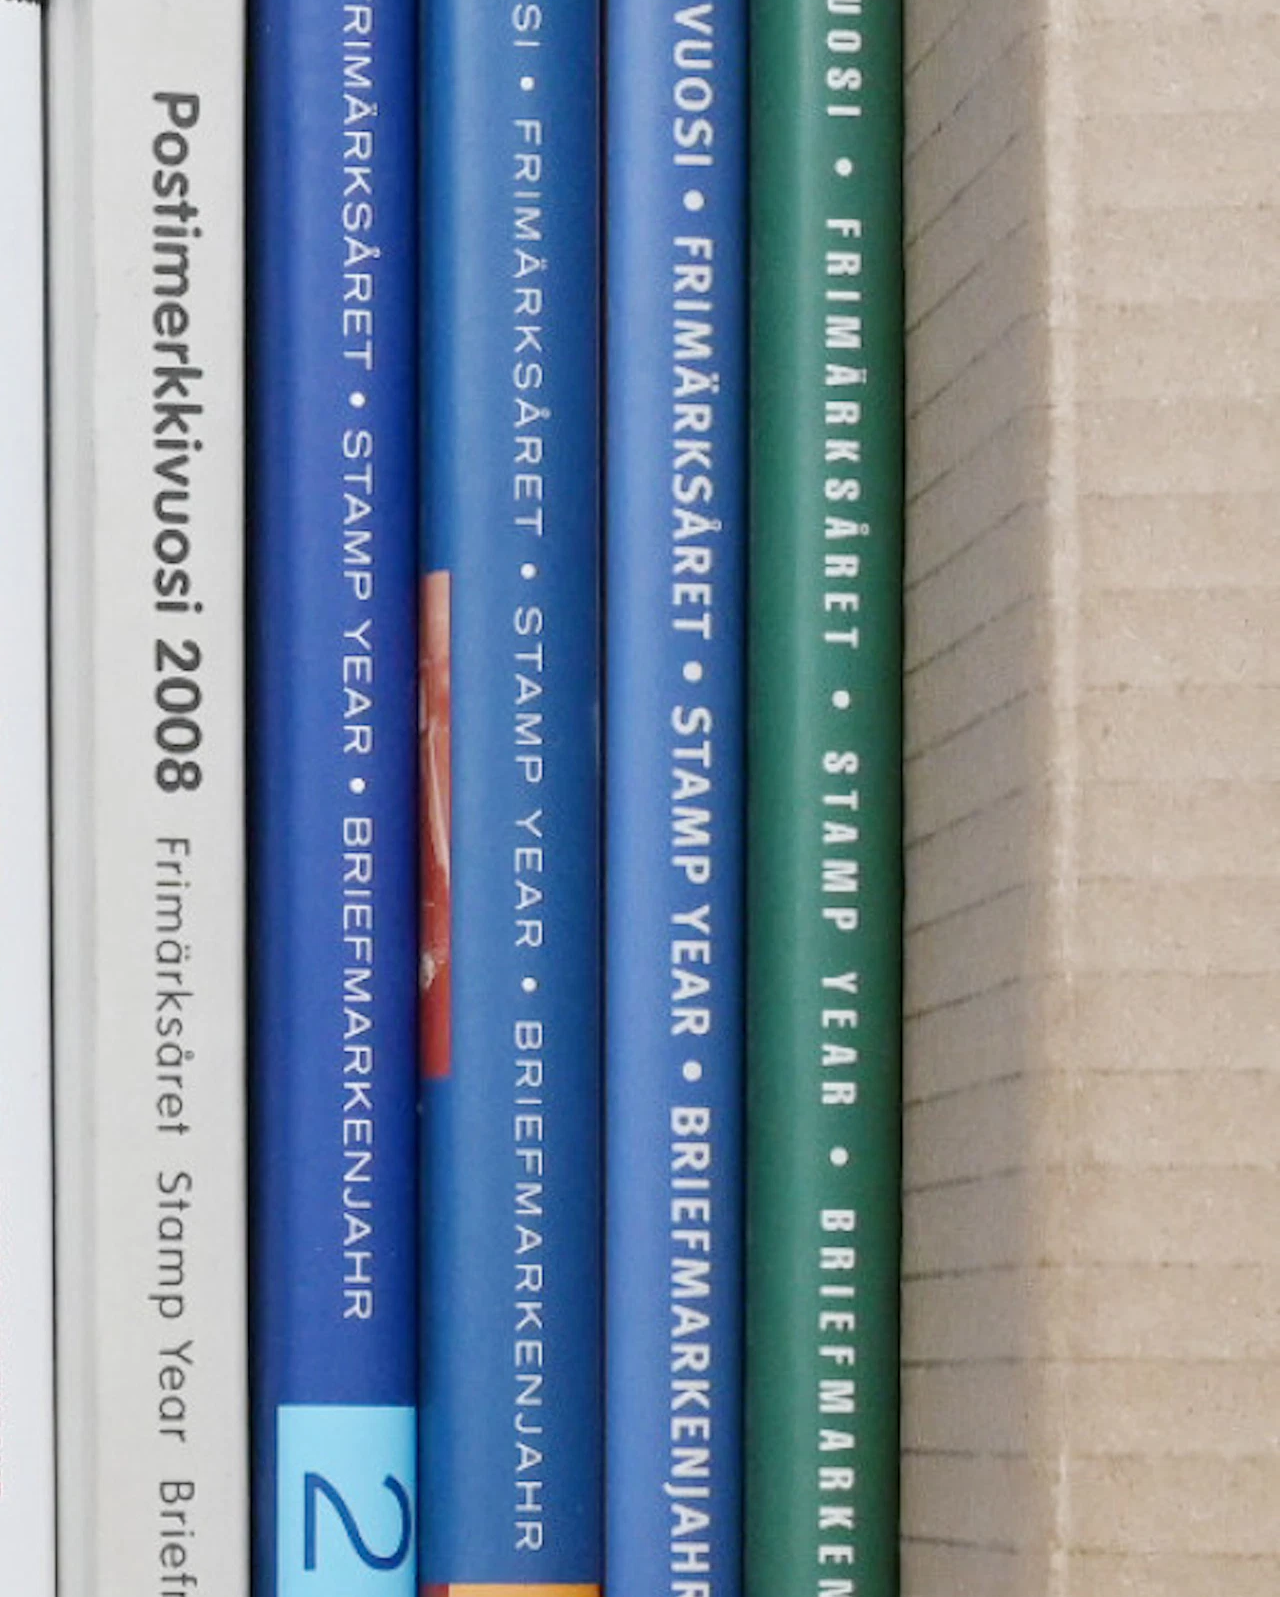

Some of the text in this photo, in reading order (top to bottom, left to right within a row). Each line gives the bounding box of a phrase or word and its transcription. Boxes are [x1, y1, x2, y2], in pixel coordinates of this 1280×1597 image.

[152, 91, 201, 613] Postimerkkivuosi
[512, 119, 552, 536] FRIMÄRKSÅRET
[342, 429, 372, 602] STAMP
[671, 235, 721, 639] FRIMÄRKSÅRET
[822, 218, 869, 650] FRIMÄRKSÅRET
[154, 638, 201, 793] 2008
[342, 621, 372, 755] YEAR
[513, 606, 543, 785] STAMP
[514, 811, 543, 948] YEAR
[670, 706, 711, 884] STAMP
[822, 751, 857, 934] STAMP
[155, 836, 193, 1137] Frimärksåret
[670, 904, 711, 1036] YEAR
[821, 973, 856, 1109] YEAR
[342, 818, 372, 1319] BRIEFMARKENJAHR
[150, 1171, 193, 1319] Stamp
[513, 1020, 544, 1552] BRIEFMARKENJAHR
[158, 1341, 192, 1441] Year
